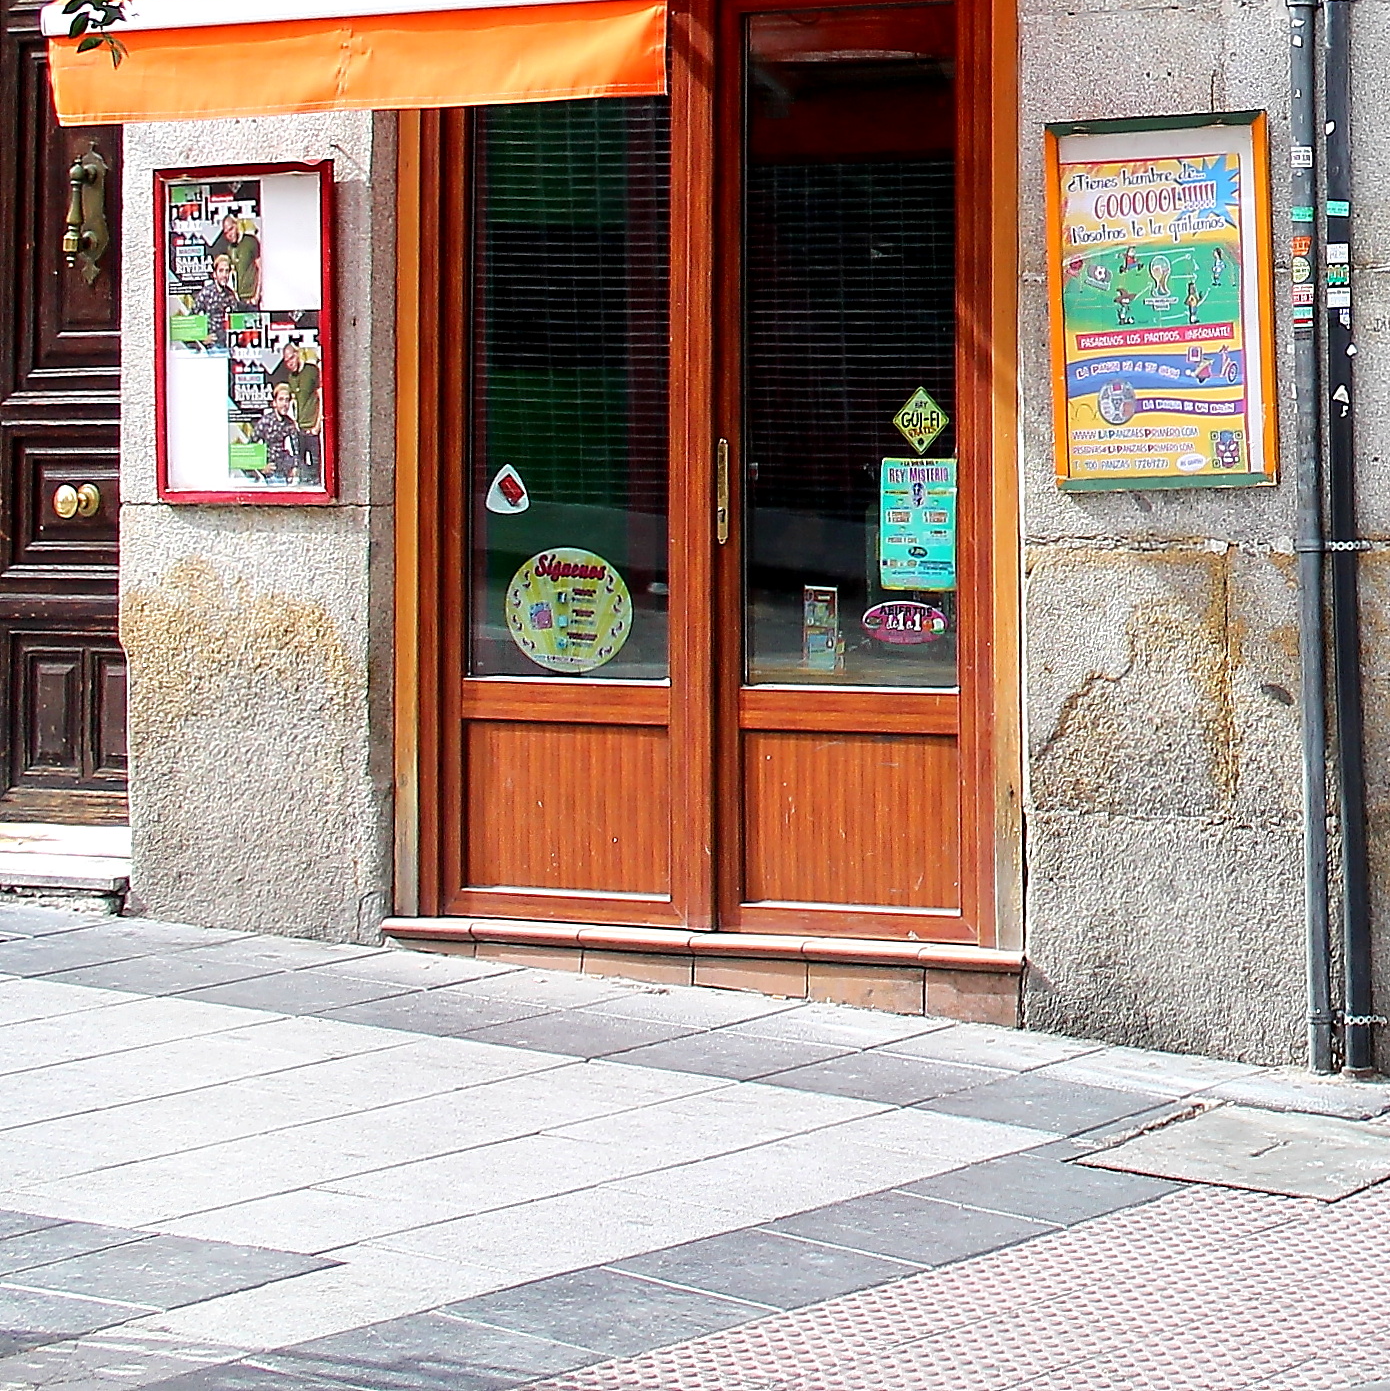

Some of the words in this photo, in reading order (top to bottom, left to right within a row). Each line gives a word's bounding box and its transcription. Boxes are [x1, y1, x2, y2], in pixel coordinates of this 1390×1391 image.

[1068, 174, 1118, 193] ¿Tienes
[1122, 167, 1173, 187] hambre
[1072, 224, 1127, 245] Nosotros
[1132, 220, 1144, 237] te
[1149, 218, 1163, 235] la
[1168, 213, 1226, 243] quitamos
[1080, 334, 1124, 348] PASAREMOS
[1126, 333, 1141, 345] LOS
[888, 468, 905, 484] REY
[908, 467, 949, 483] MISTERIO
[535, 554, 607, 582] Síguenos
[879, 604, 934, 618] ABIERTOS
